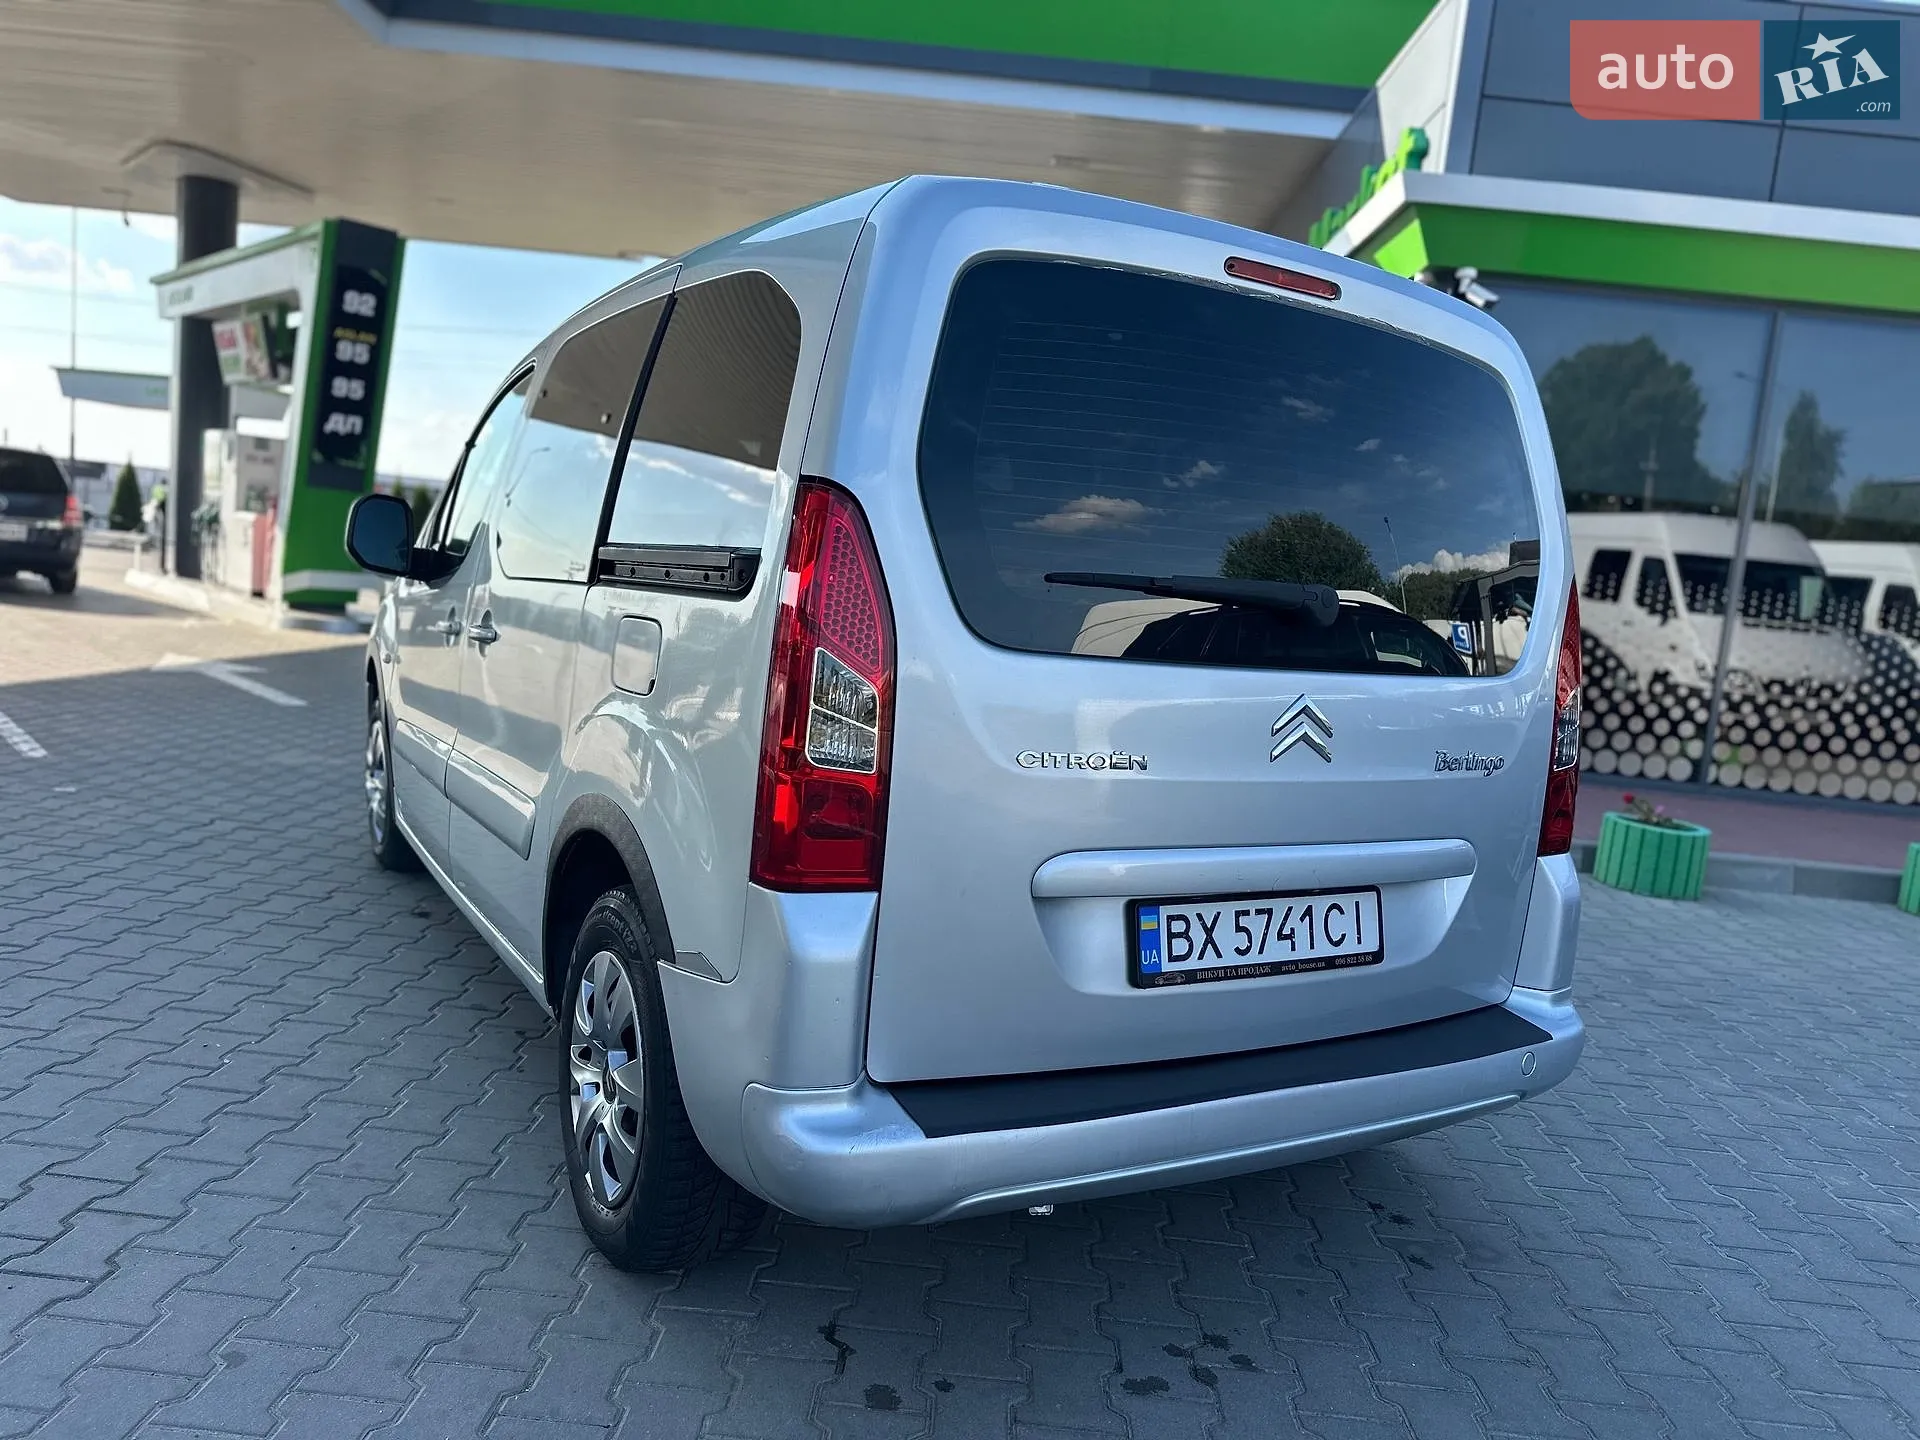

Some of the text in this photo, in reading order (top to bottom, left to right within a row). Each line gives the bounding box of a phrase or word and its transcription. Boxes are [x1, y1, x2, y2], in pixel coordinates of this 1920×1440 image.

[342, 289, 377, 317] 92
[335, 340, 371, 365] 95
[331, 375, 366, 401] 95
[1016, 750, 1148, 771] CITROËN
[1434, 749, 1505, 777] Berlingo
[1141, 949, 1160, 965] UA
[1197, 964, 1272, 980] ВИКУП ТА ПРОДАЖ
